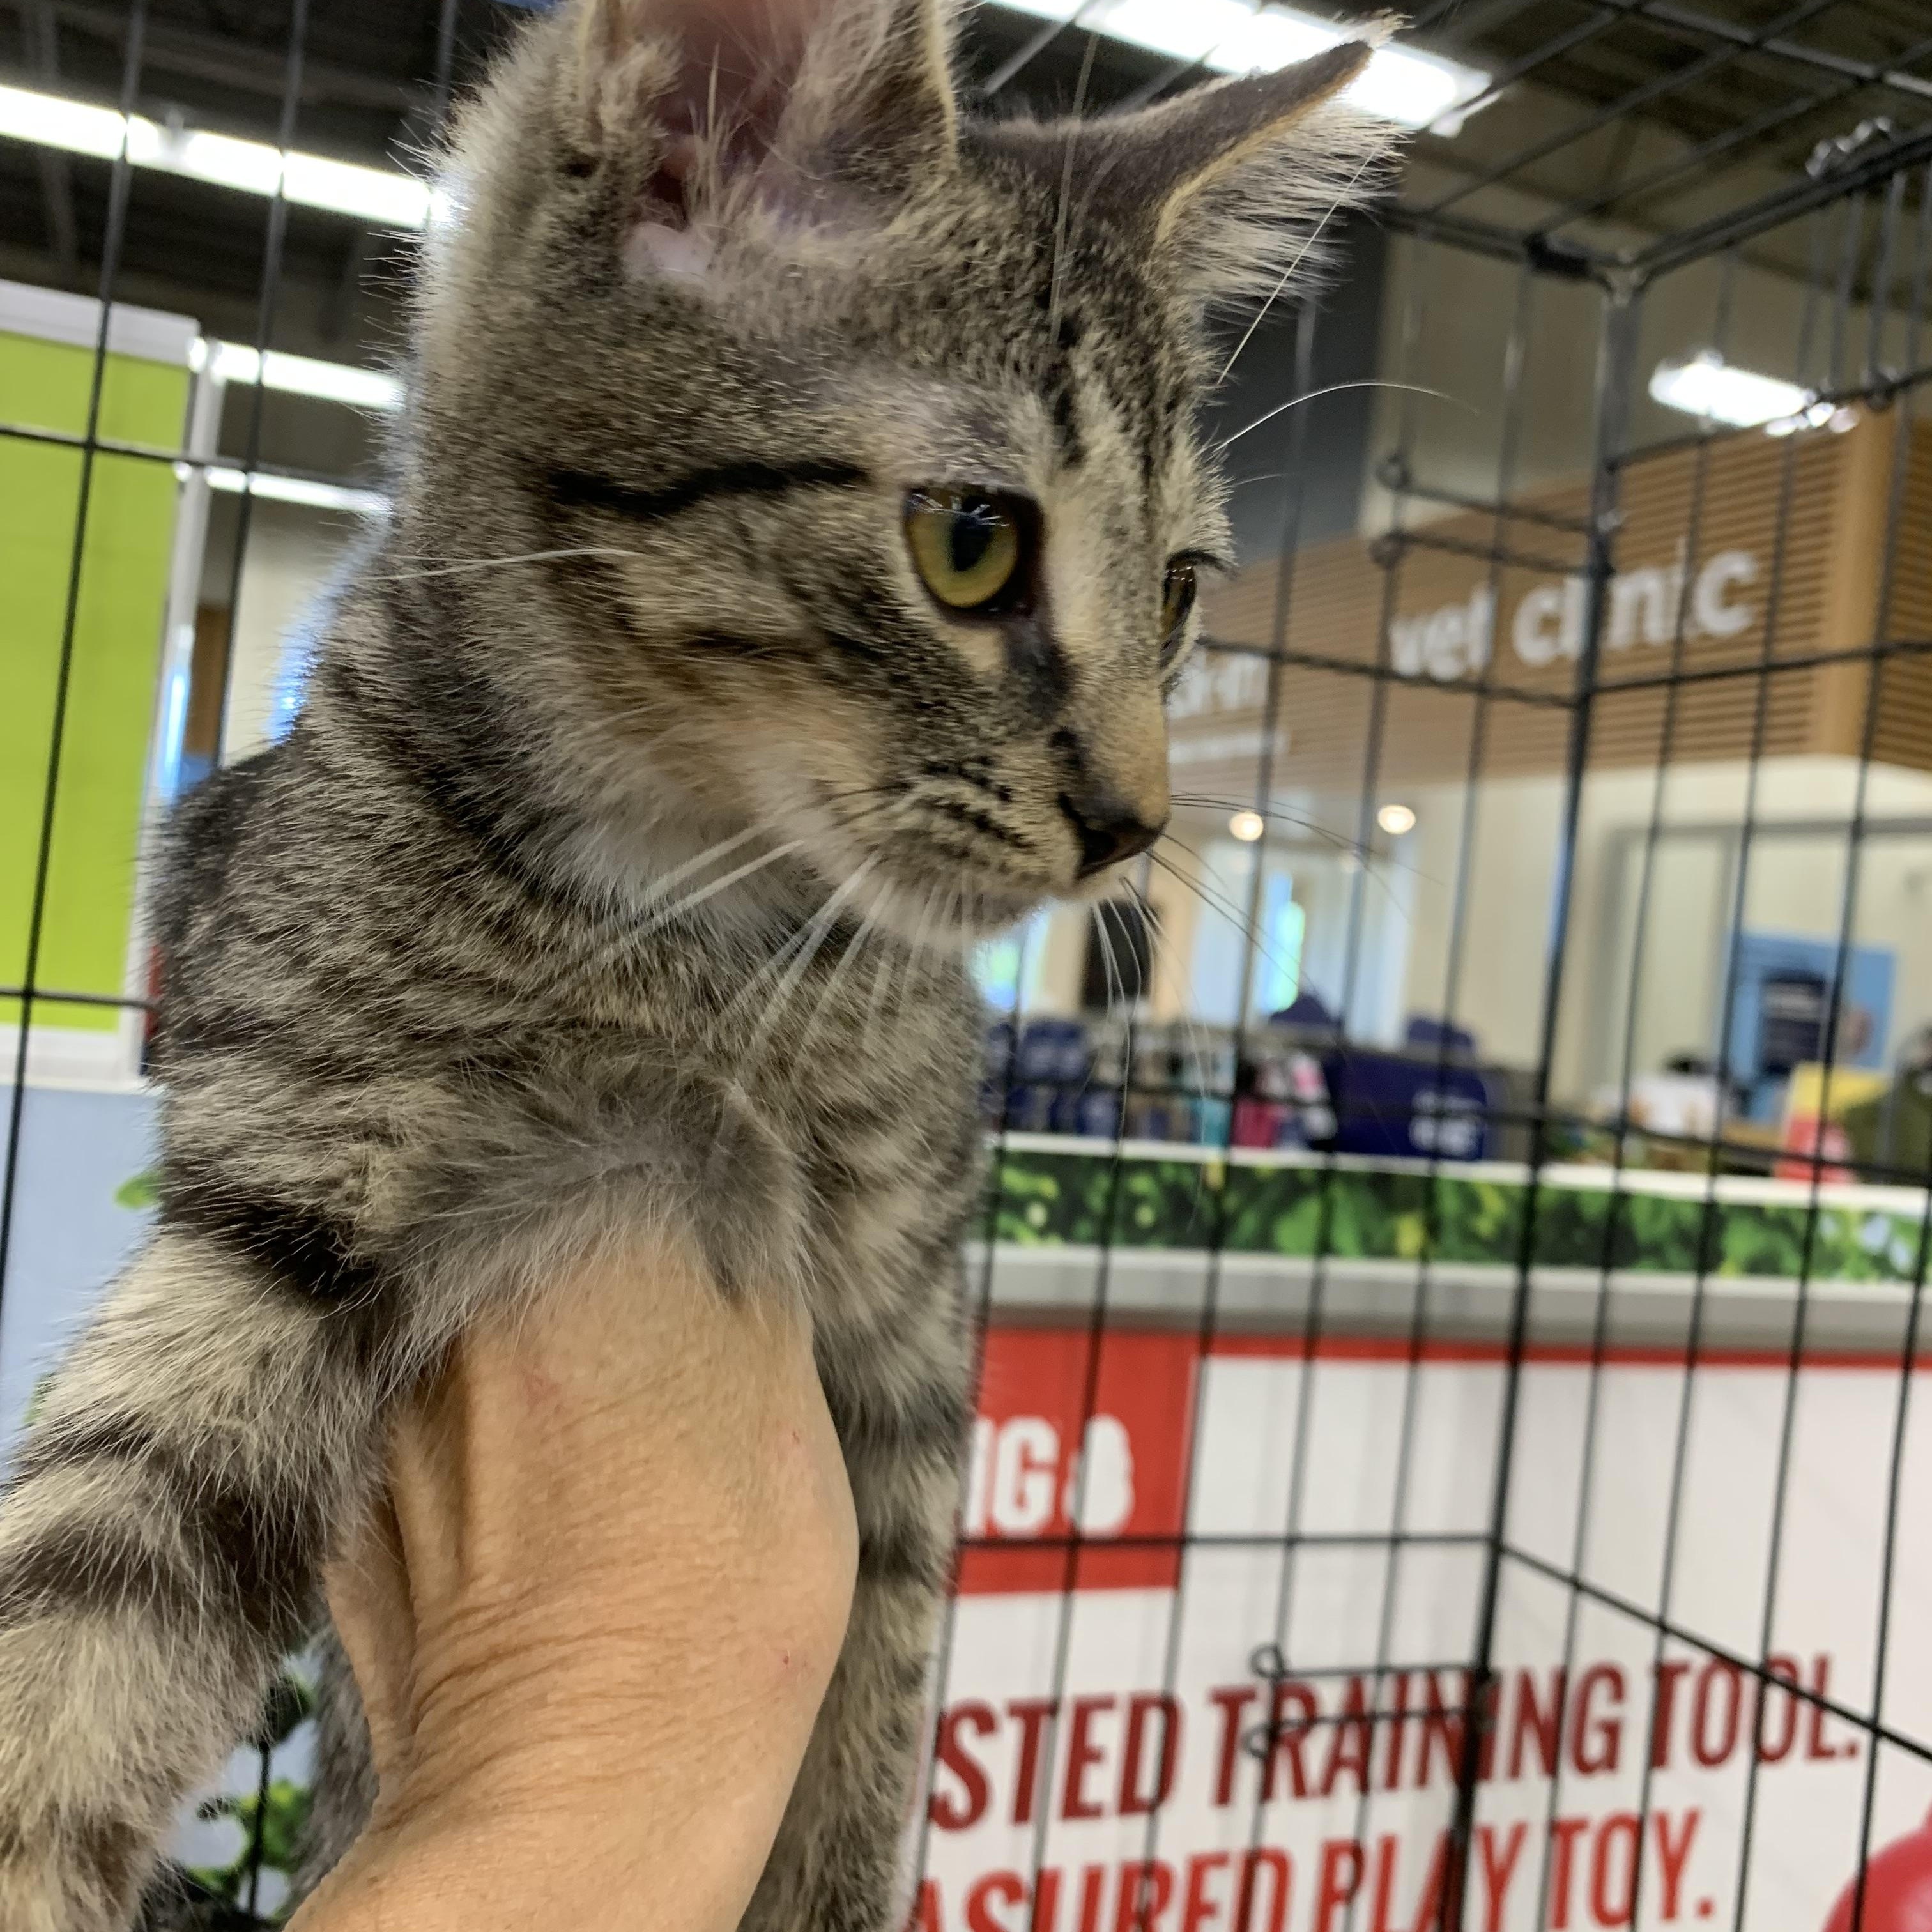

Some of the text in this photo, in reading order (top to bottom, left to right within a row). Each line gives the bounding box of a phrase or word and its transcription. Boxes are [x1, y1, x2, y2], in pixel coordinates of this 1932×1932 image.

[1512, 539, 1758, 668] clnic
[928, 1653, 1860, 1834] STED TRAINING TOOL.
[1314, 1819, 1529, 1932] PLAY
[1547, 1807, 1717, 1932] TOY.
